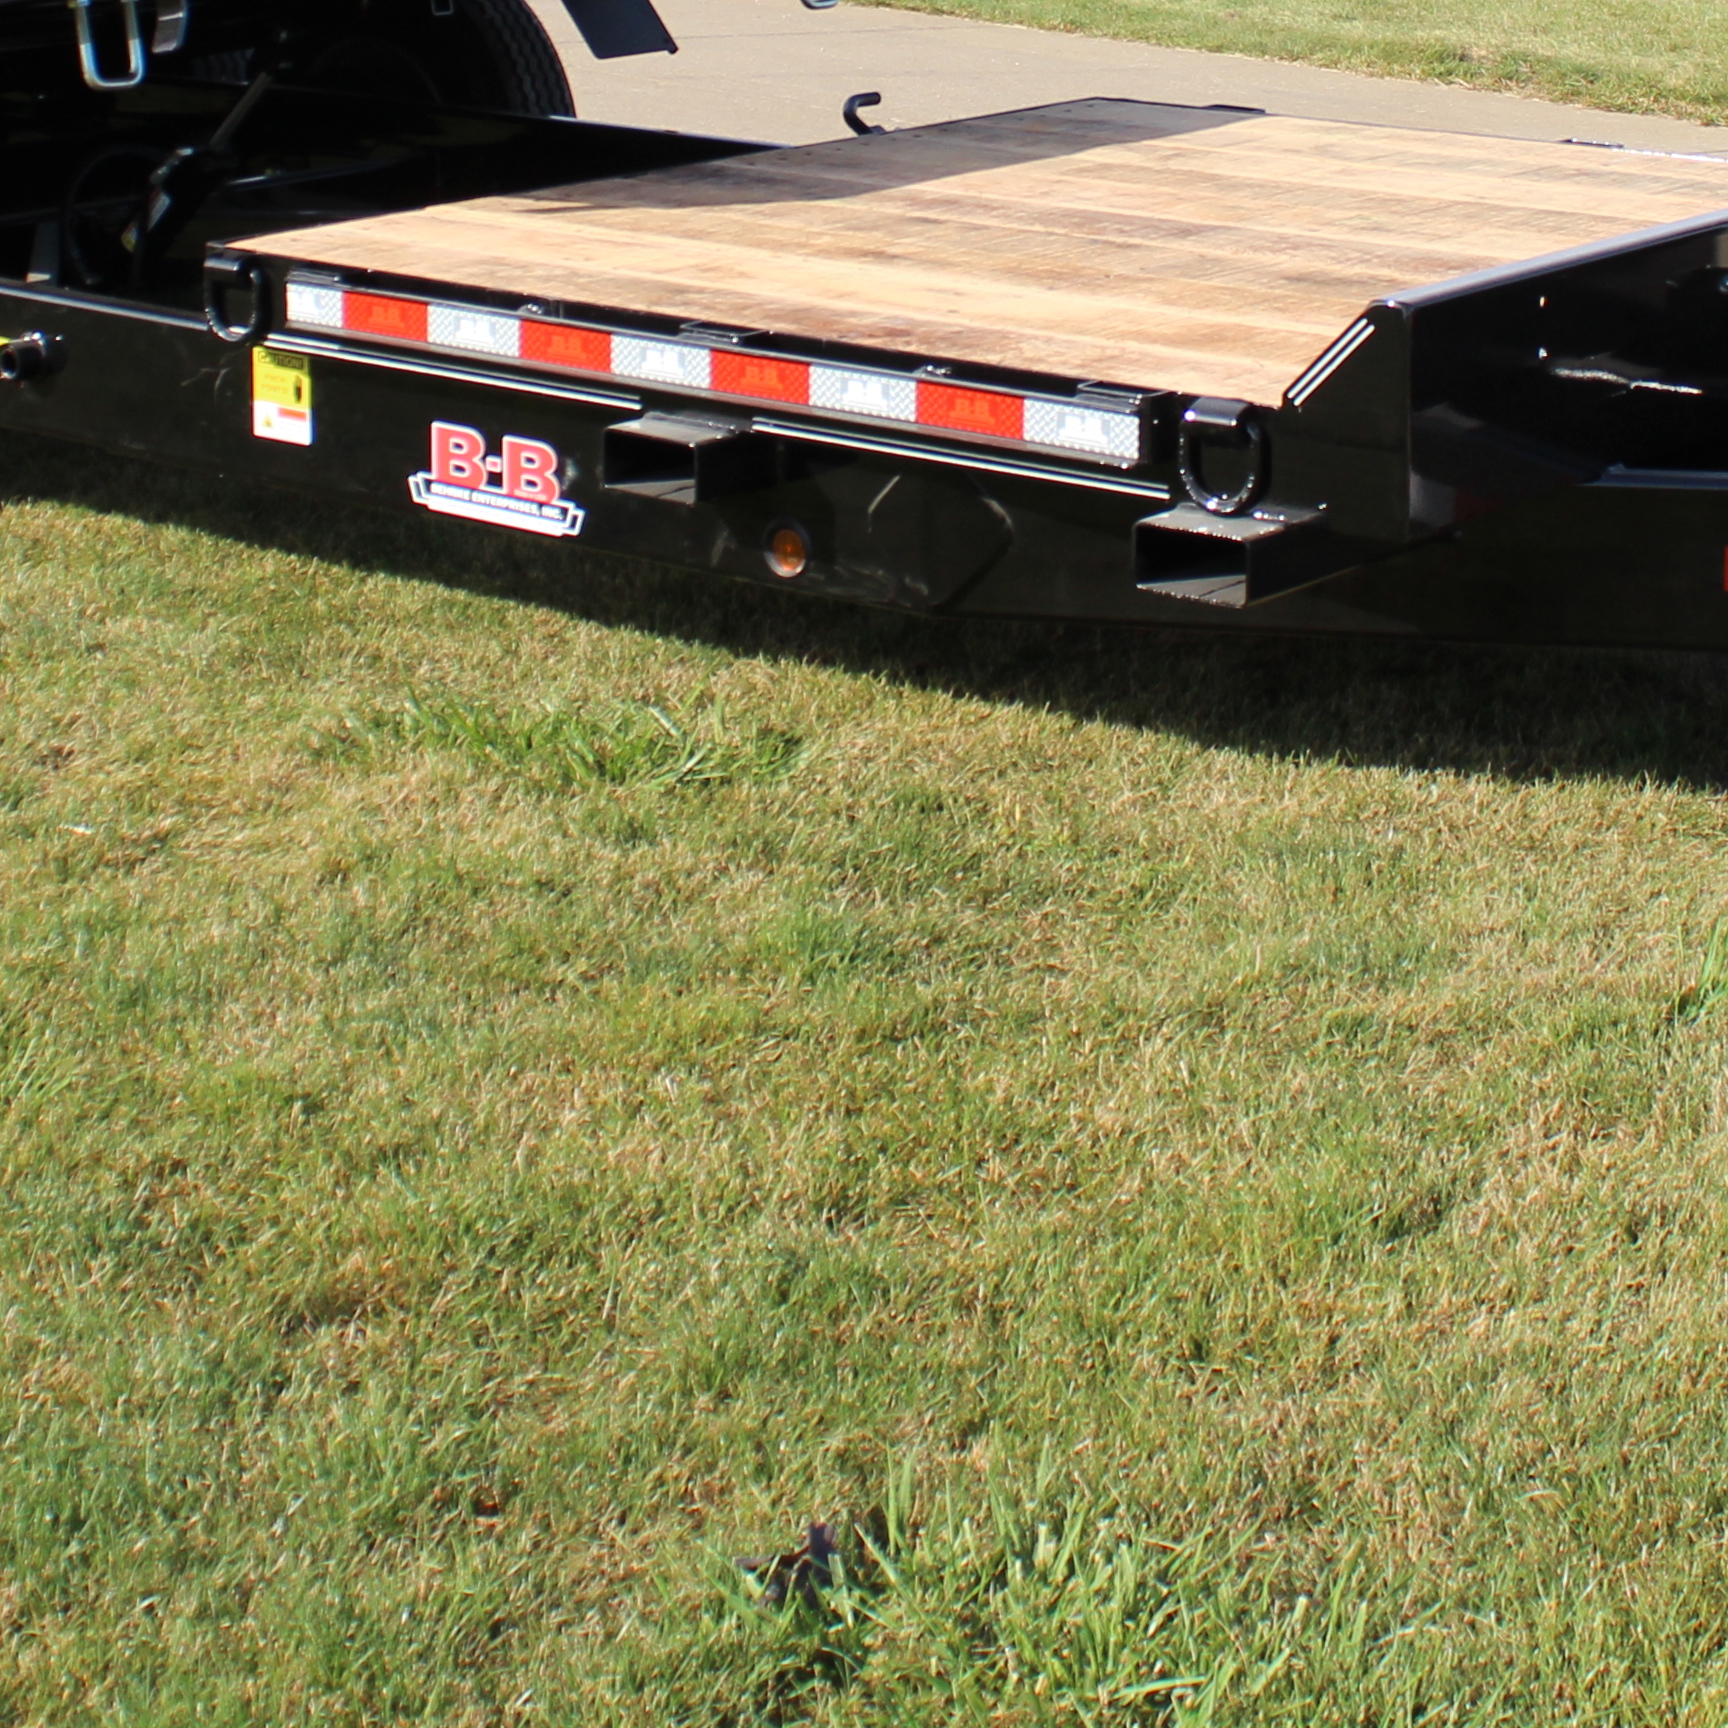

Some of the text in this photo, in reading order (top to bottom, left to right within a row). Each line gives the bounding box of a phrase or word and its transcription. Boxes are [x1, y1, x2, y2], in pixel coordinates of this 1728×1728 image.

[431, 421, 561, 505] B-B
[471, 492, 540, 516] ENTERPRISES,
[541, 506, 563, 520] INC.
